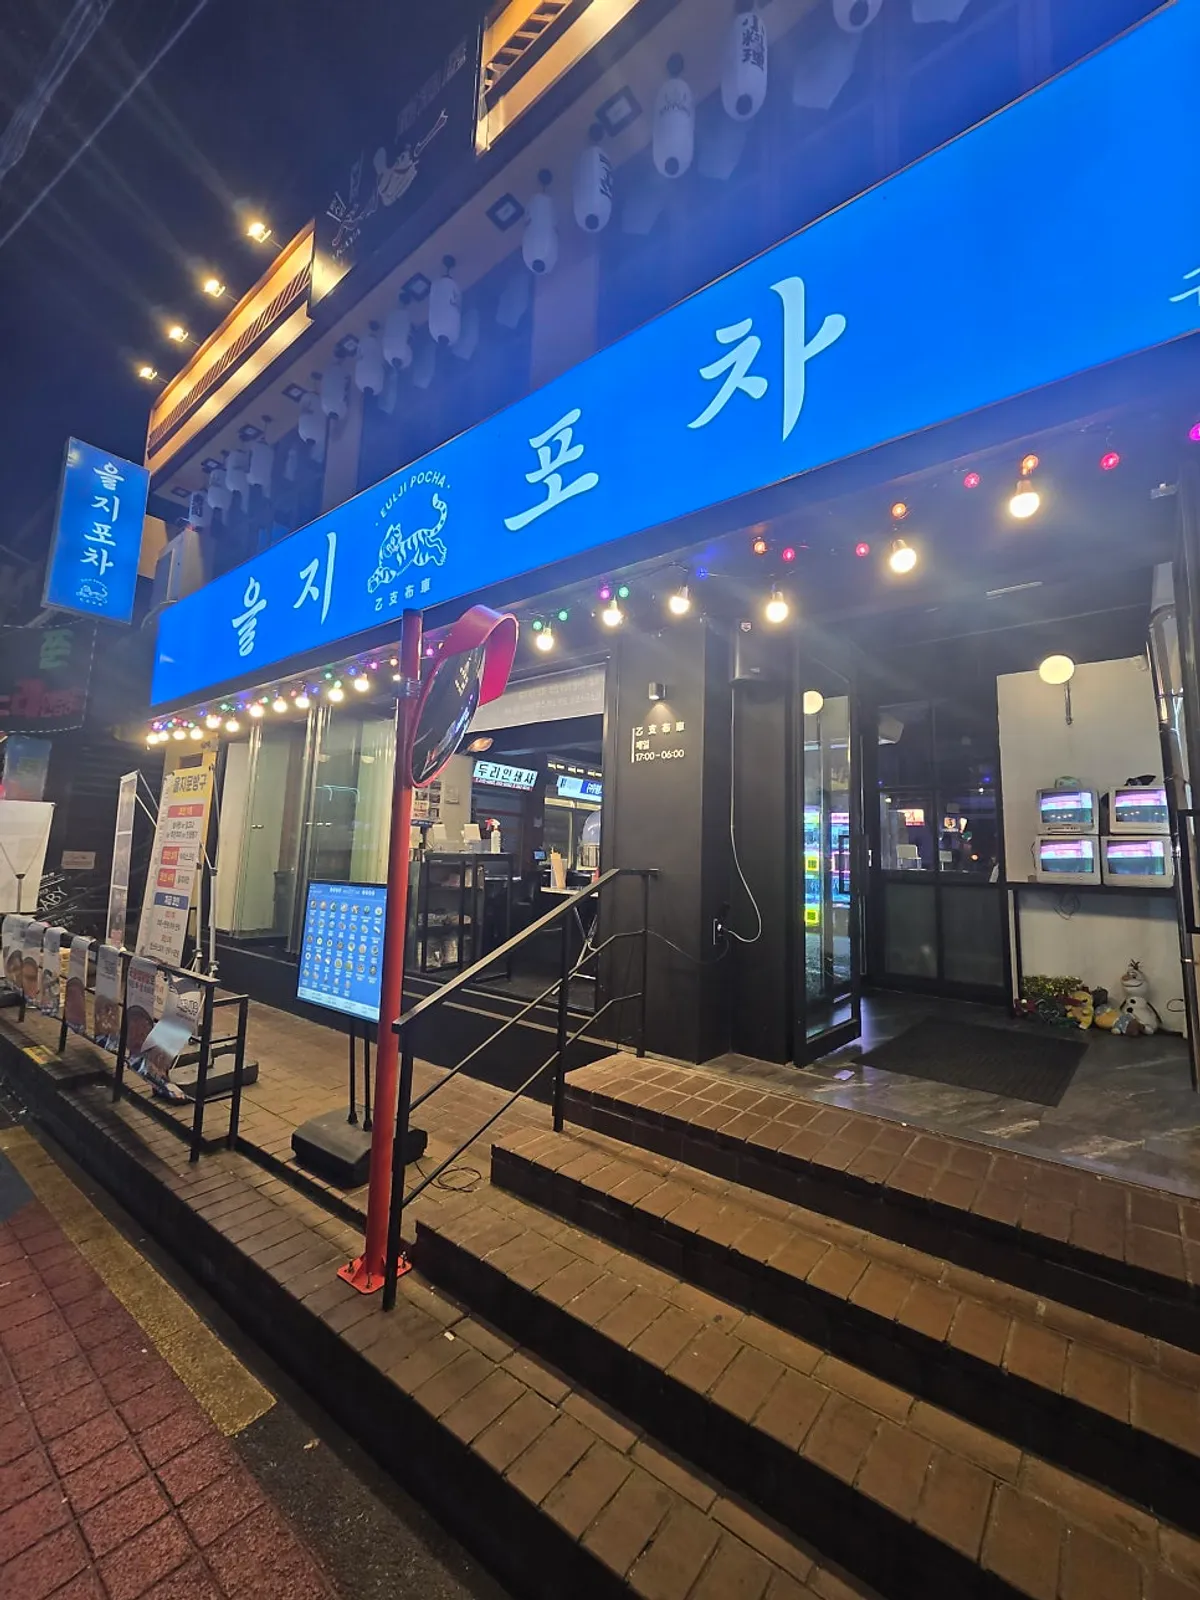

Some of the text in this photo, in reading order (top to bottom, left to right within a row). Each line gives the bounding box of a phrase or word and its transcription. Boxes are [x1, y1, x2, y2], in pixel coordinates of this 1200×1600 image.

[80, 462, 125, 576] 을지포차
[380, 470, 447, 518] EULJI POCHA
